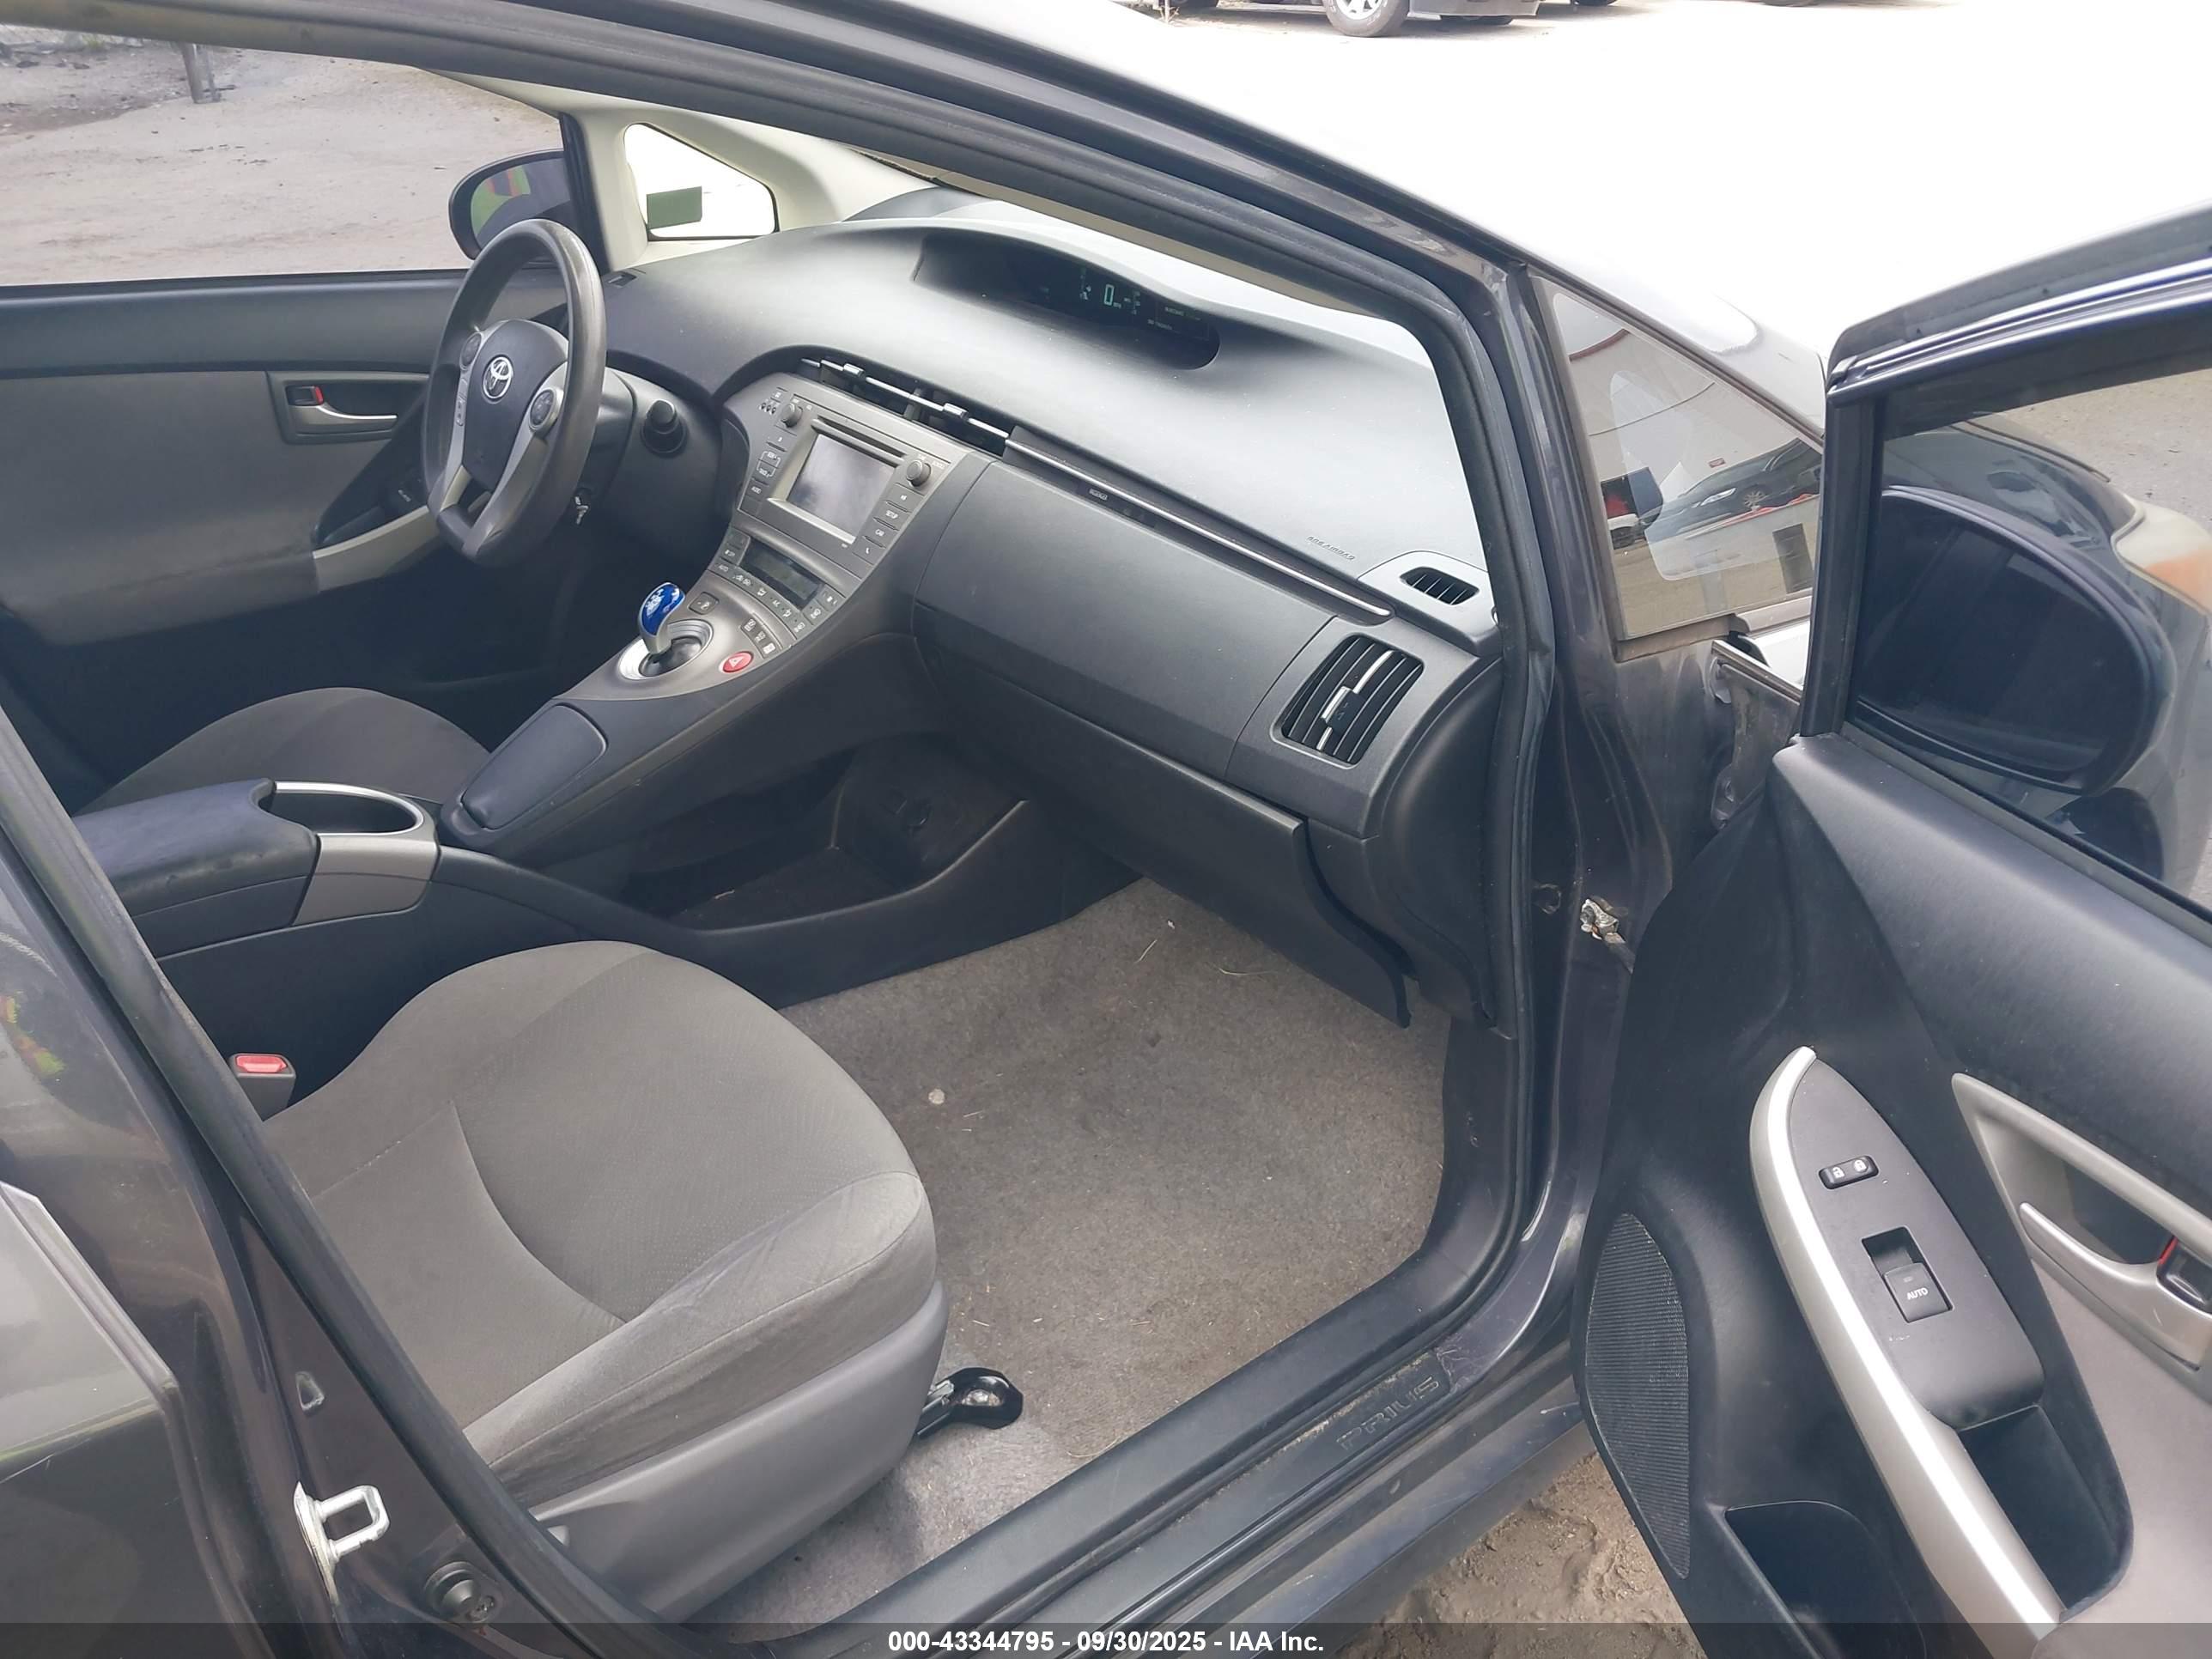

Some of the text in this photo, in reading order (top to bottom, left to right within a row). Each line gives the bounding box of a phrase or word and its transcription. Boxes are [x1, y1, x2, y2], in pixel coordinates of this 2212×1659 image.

[1103, 283, 1115, 306] 0
[1906, 1287, 1929, 1300] AUTO
[1336, 1376, 1439, 1450] PRIUS
